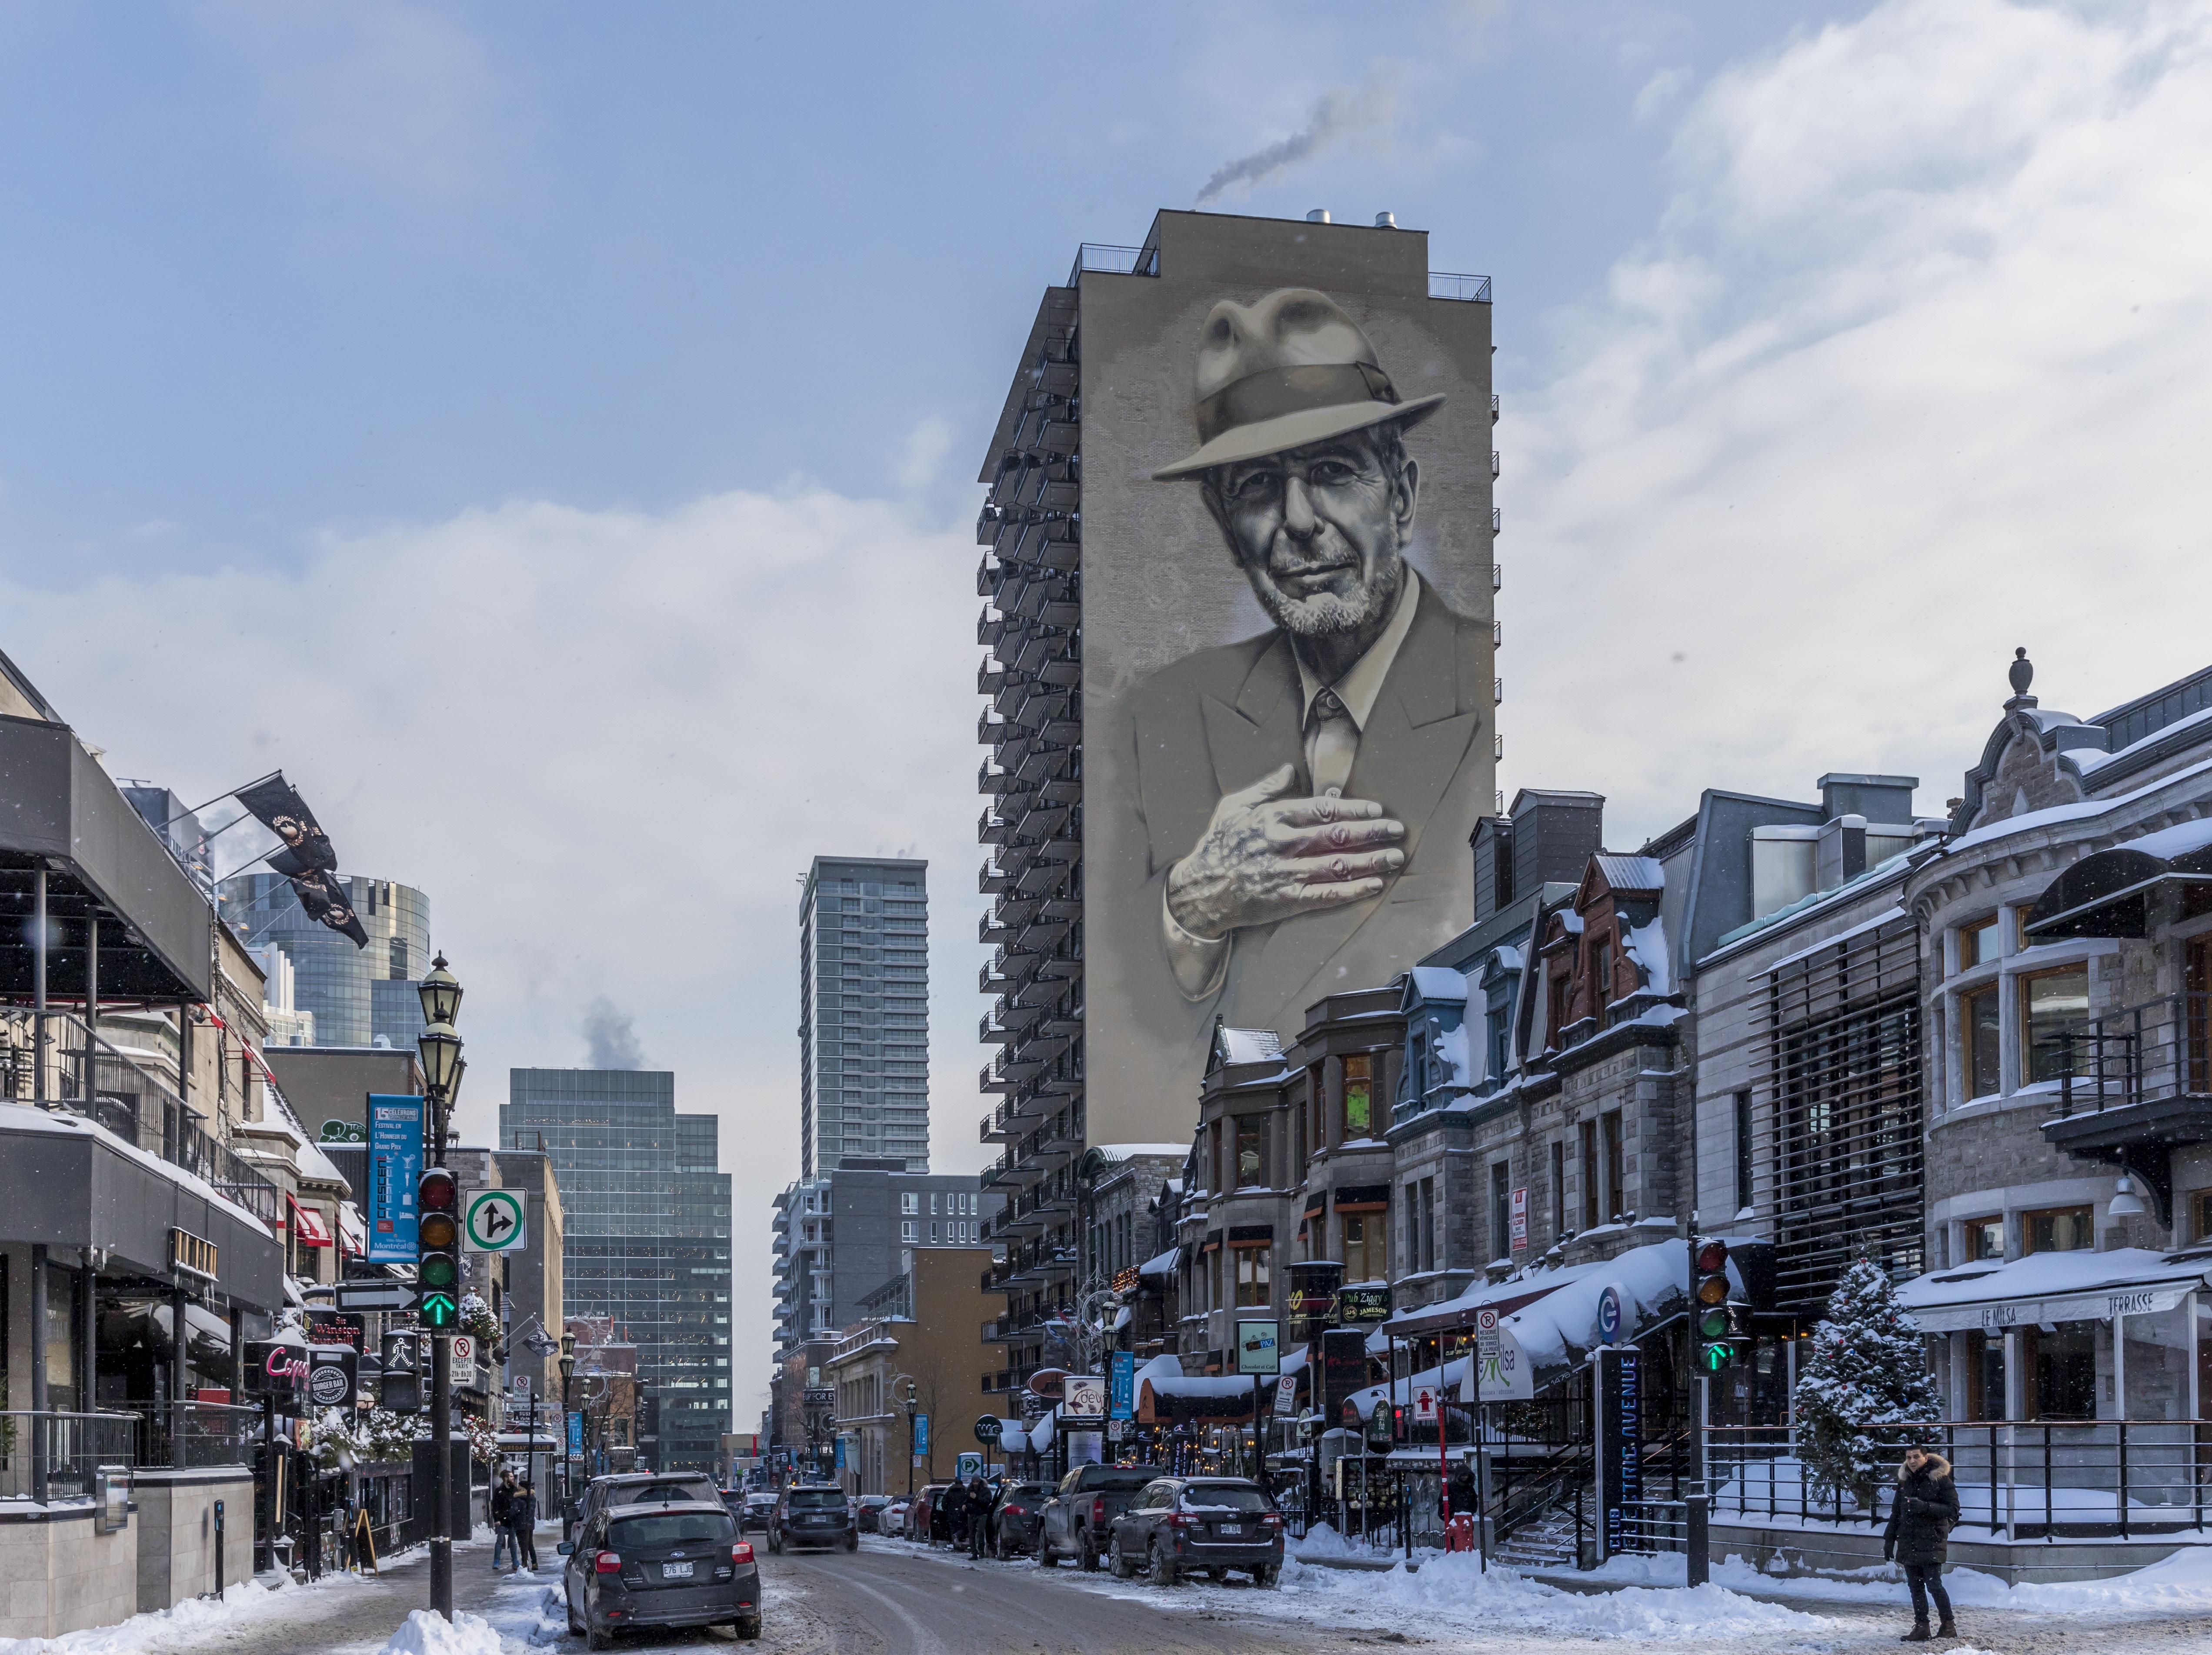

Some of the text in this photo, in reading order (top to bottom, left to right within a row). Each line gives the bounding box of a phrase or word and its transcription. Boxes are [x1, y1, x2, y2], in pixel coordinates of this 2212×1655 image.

[1344, 1291, 1388, 1305] Pub Ziggy's
[1982, 1308, 2016, 1327] LE MILSA
[315, 1324, 360, 1334] Winston
[1260, 1339, 1273, 1348] PAZ
[313, 1381, 332, 1391] BURGER
[333, 1379, 344, 1388] BAR
[1621, 1357, 1638, 1549] ELECTRIC AVENUE
[1609, 1508, 1621, 1548] CLUB
